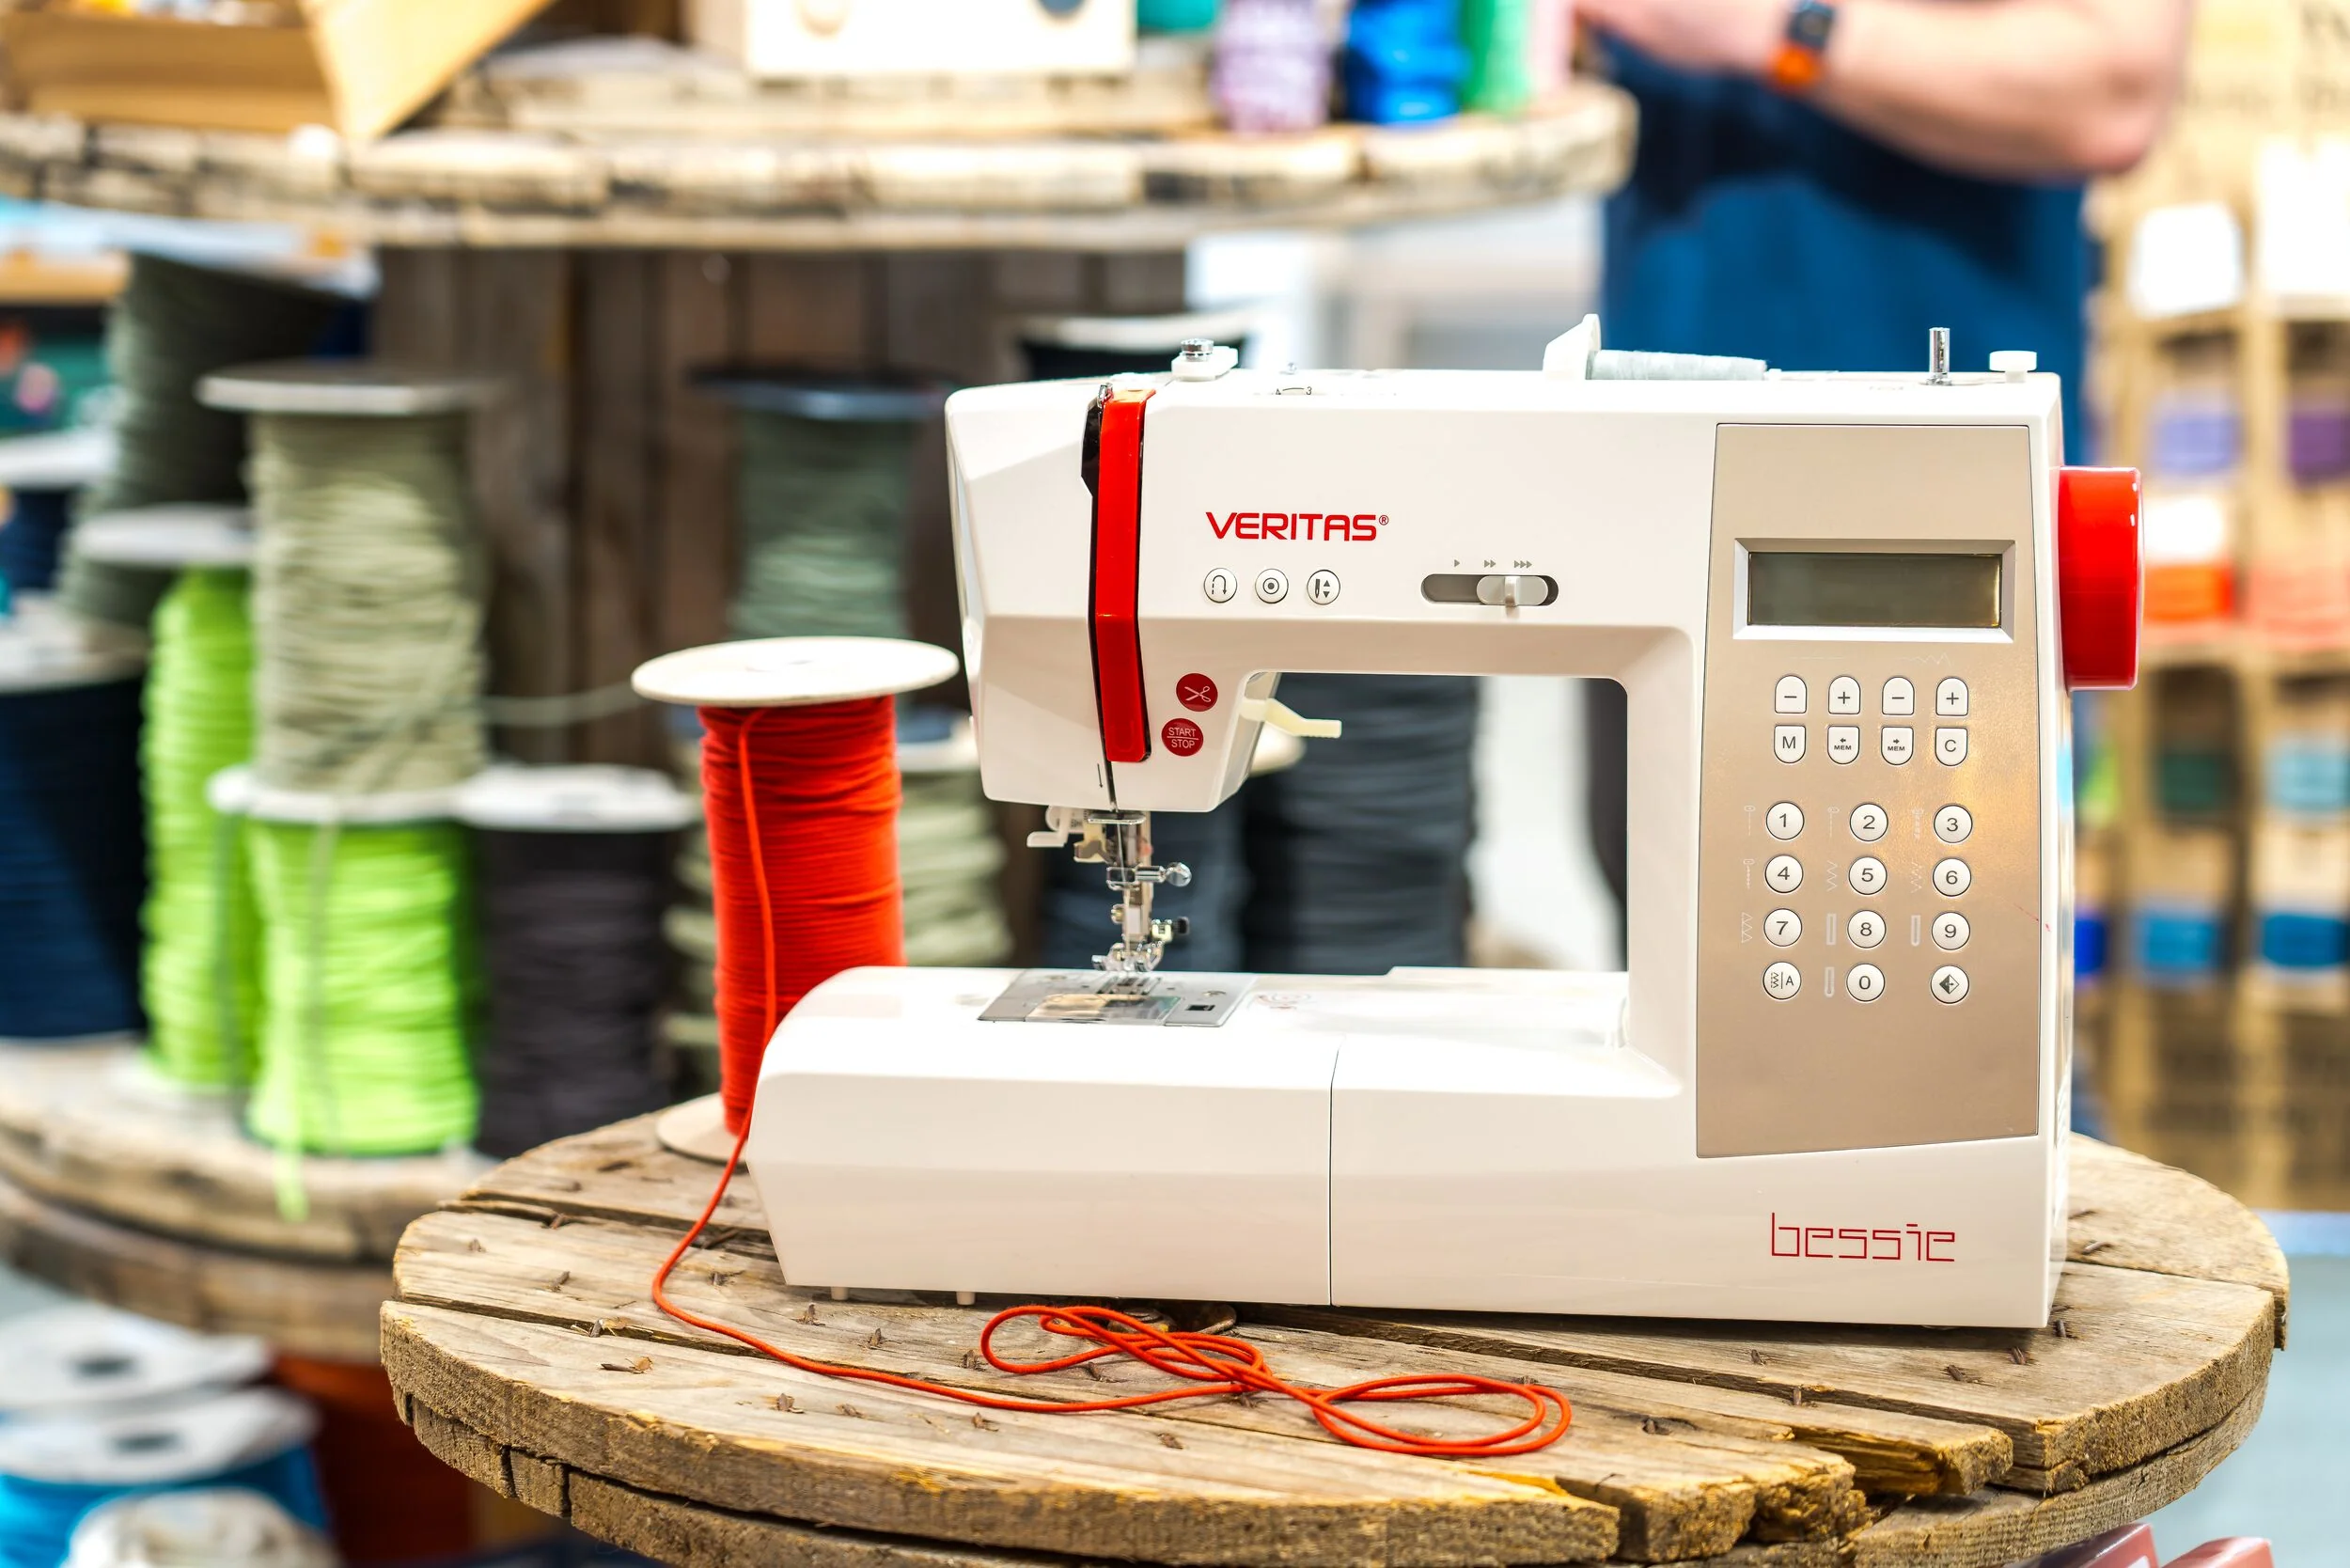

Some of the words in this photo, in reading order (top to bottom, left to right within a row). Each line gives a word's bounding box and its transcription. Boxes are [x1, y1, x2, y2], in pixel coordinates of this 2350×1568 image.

[1167, 727, 1197, 738] START
[1171, 738, 1196, 749] STOP
[1782, 736, 1796, 749] M
[1944, 739, 1957, 753] C
[1778, 813, 1787, 828] 1
[1862, 814, 1875, 830] 2
[1946, 817, 1959, 832] 3
[1777, 866, 1790, 881] 4
[1861, 868, 1874, 883] 5
[1945, 870, 1958, 885] 6
[1776, 920, 1789, 935] 7
[1859, 922, 1872, 937] 8
[1944, 924, 1957, 938] 9
[1858, 975, 1872, 990] 0
[1772, 1213, 1955, 1262] bessie
